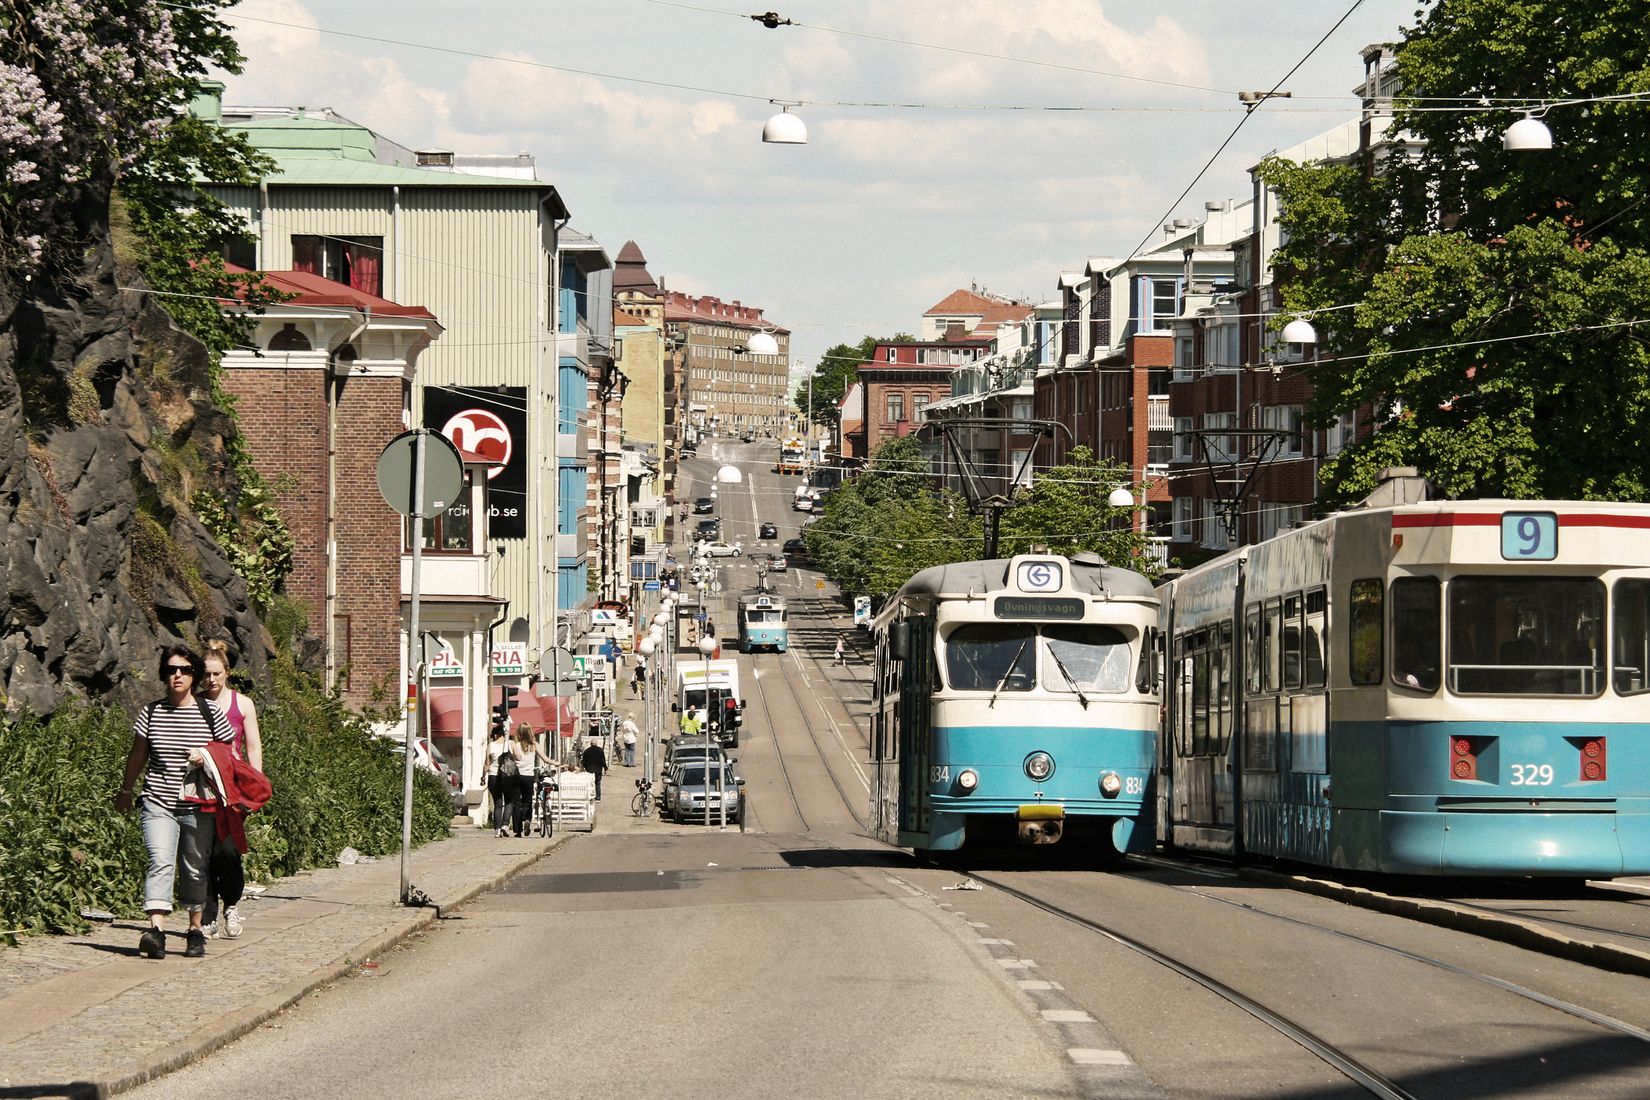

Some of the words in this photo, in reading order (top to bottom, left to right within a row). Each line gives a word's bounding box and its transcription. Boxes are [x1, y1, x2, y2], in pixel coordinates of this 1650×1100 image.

[1517, 516, 1541, 555] 9
[930, 766, 949, 783] 834
[1510, 764, 1553, 785] 329
[1126, 777, 1143, 794] 834
